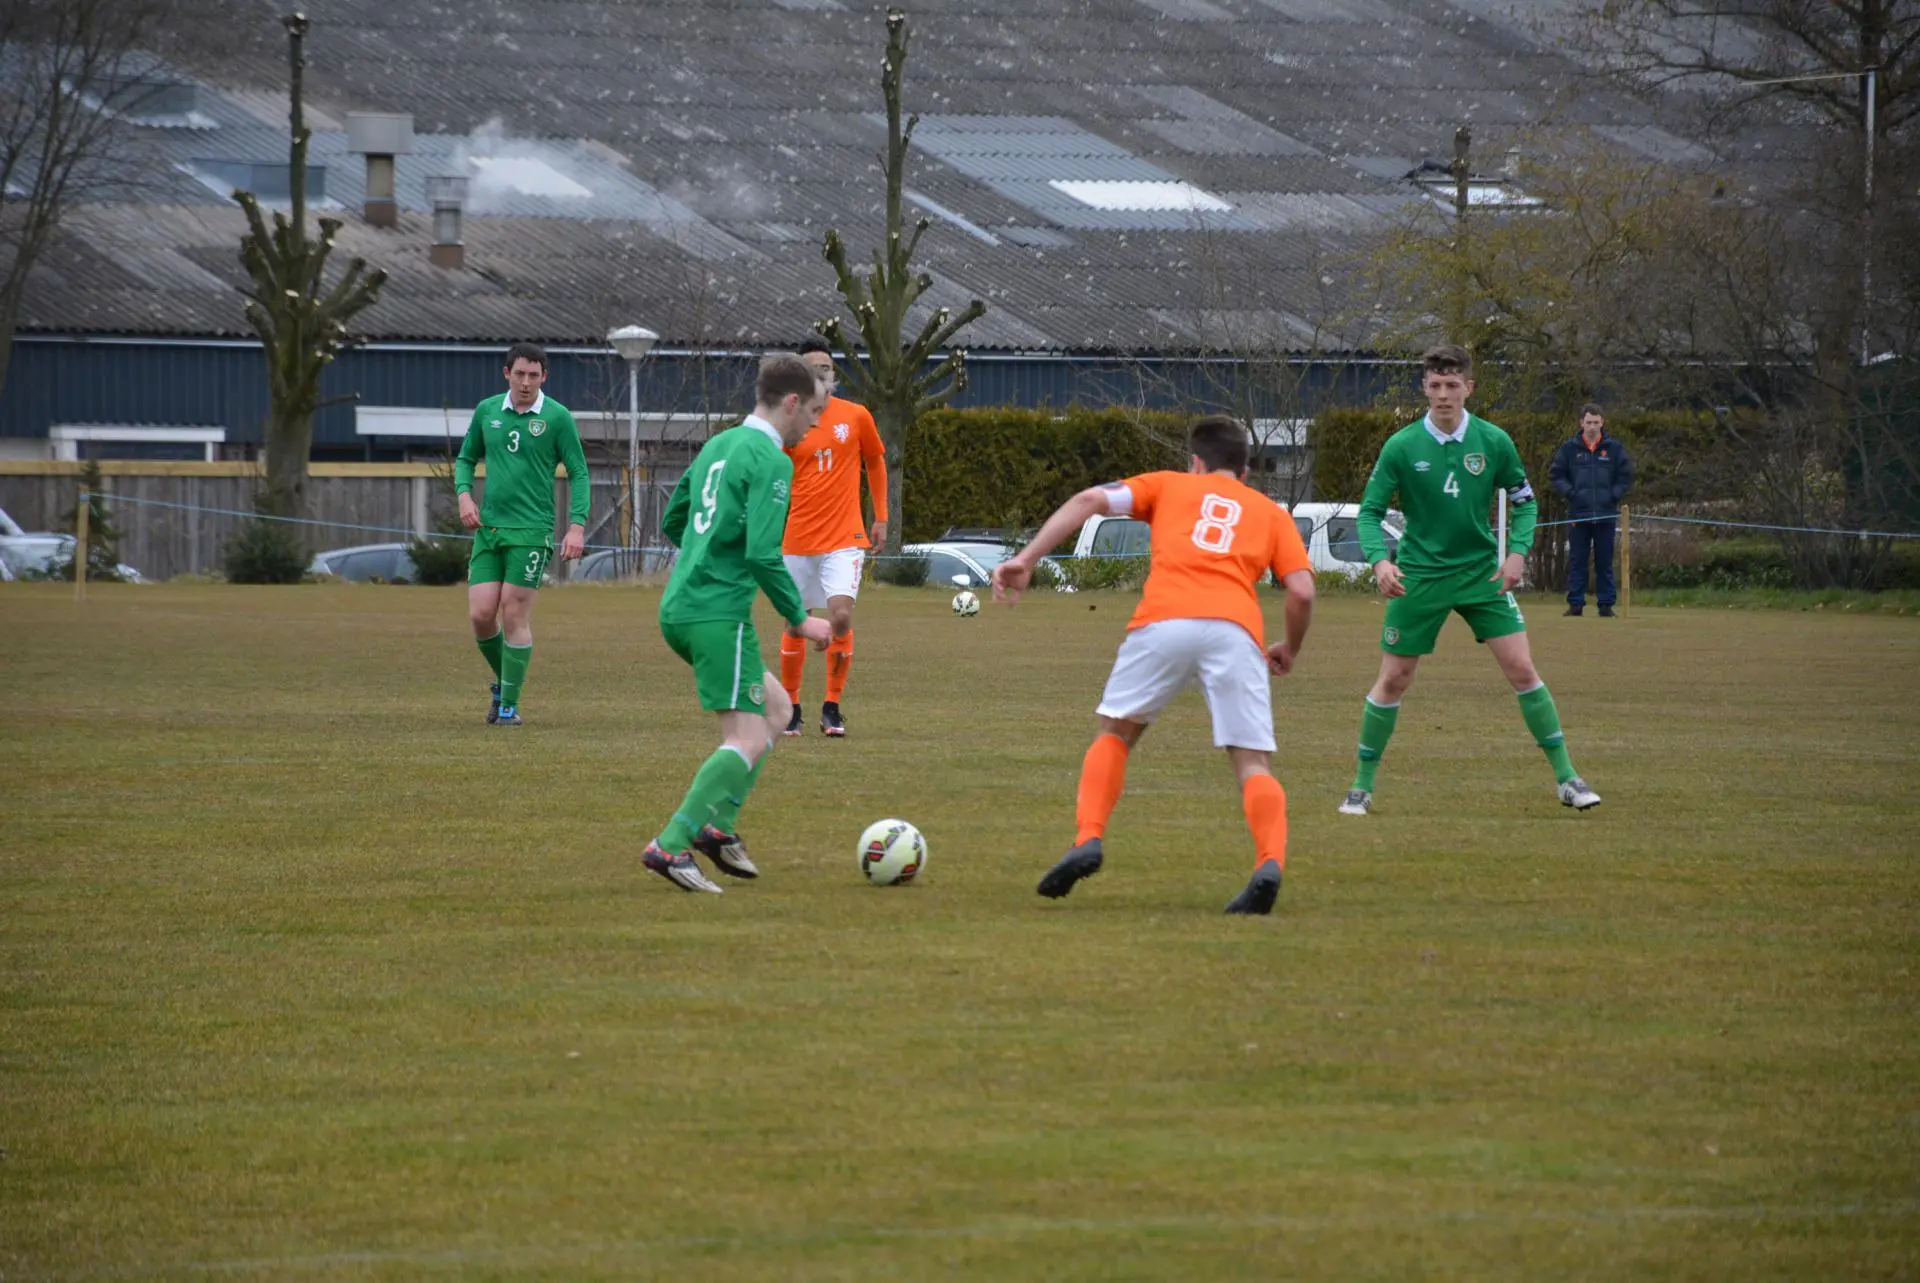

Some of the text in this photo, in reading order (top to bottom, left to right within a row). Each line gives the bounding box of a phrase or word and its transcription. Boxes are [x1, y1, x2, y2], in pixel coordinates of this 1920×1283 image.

[507, 430, 520, 452] 3
[814, 448, 833, 472] 11
[694, 459, 727, 534] 9
[1443, 471, 1460, 498] 4
[1191, 493, 1243, 554] 8
[525, 551, 540, 574] 3
